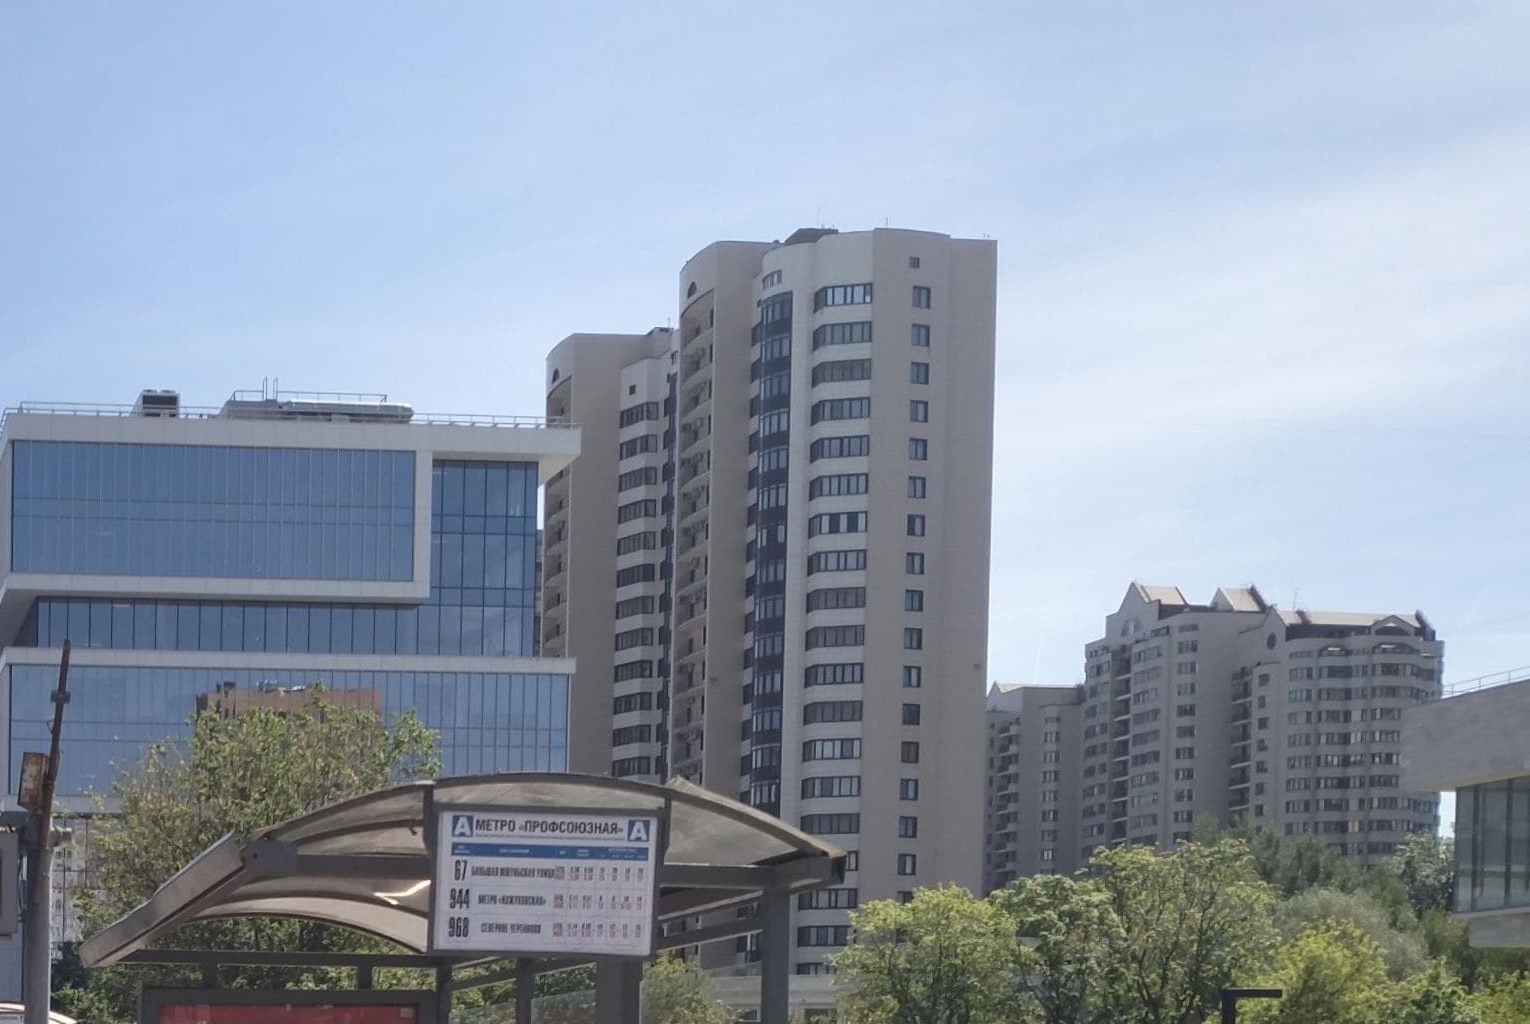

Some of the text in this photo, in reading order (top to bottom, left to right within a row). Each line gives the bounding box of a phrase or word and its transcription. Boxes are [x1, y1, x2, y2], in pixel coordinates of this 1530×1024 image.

[475, 818, 516, 833] МЕТРО
[518, 820, 624, 836] «ПРОФСОЮЗНАЯ»
[454, 860, 468, 881] 67
[450, 888, 470, 909] 944
[448, 917, 470, 938] 968
